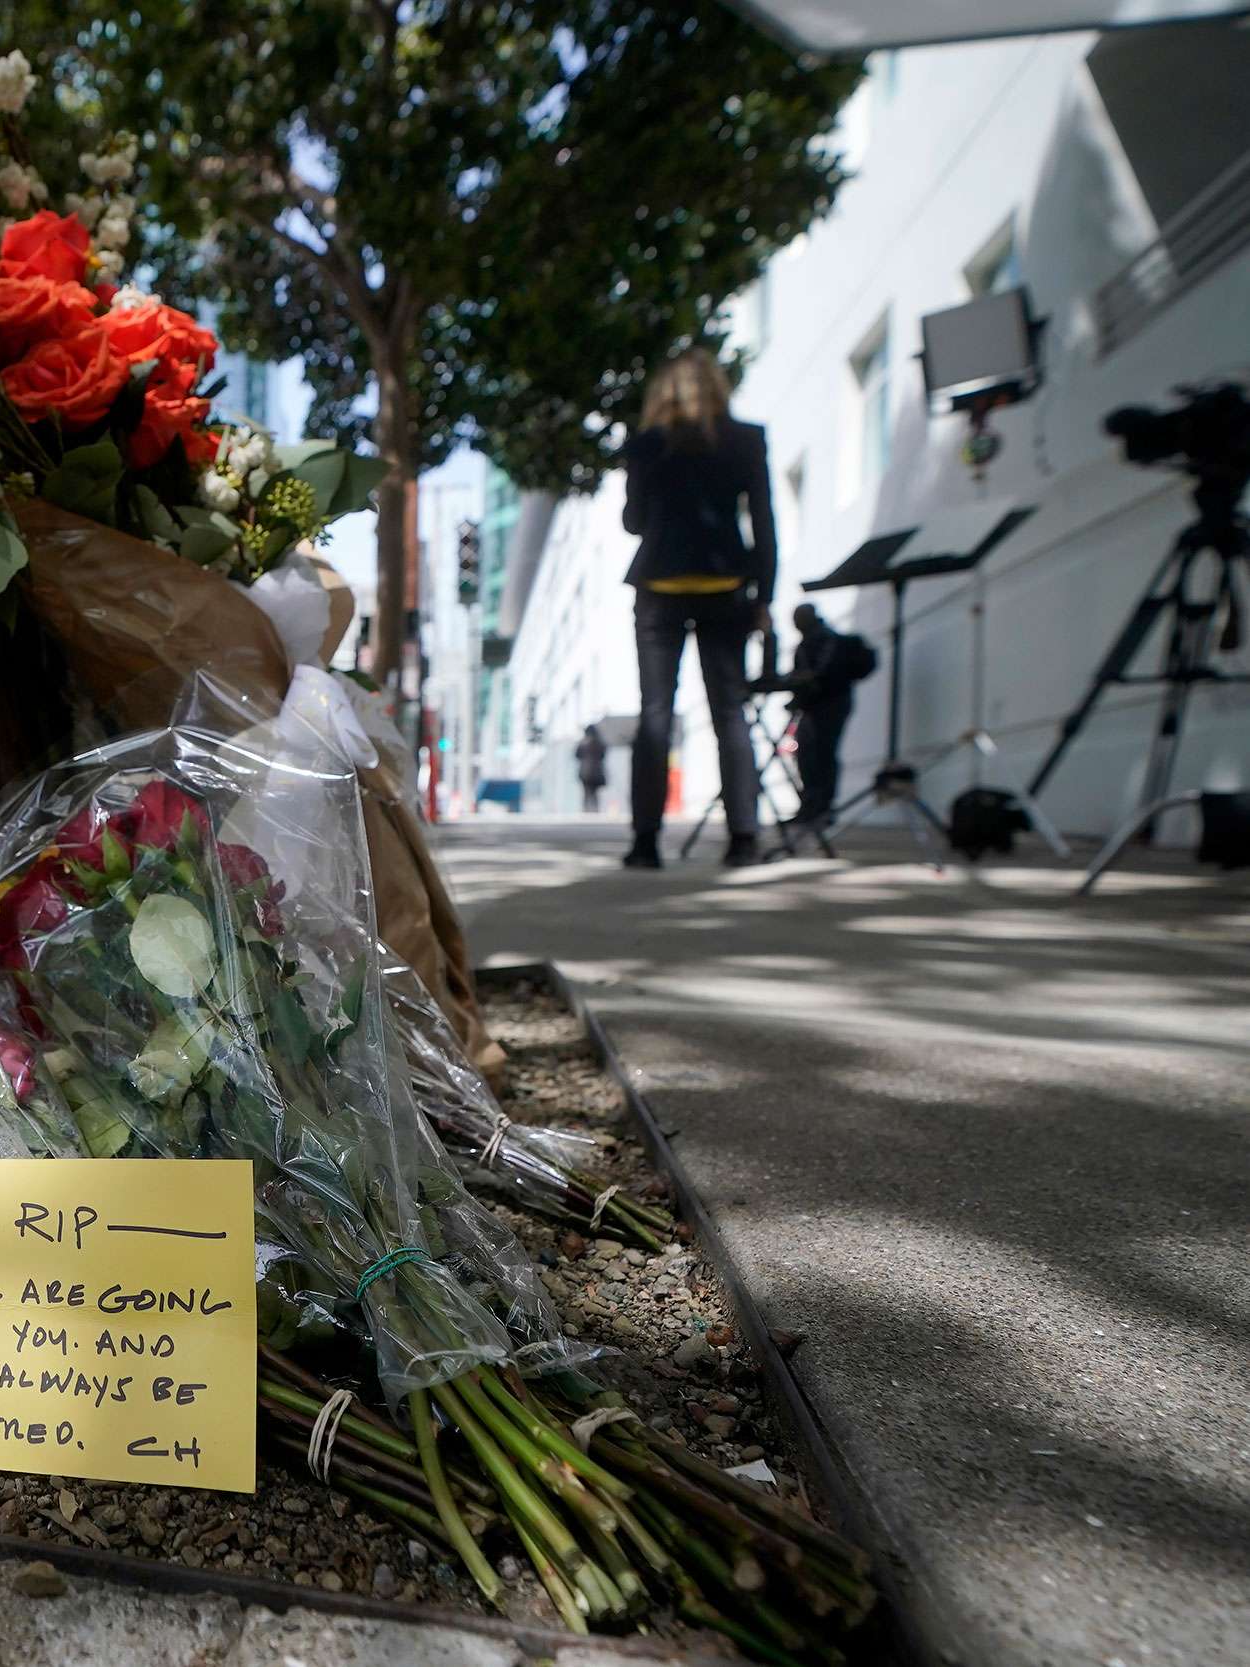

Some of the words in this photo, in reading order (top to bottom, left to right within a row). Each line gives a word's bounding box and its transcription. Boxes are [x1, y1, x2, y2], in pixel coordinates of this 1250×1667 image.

[20, 1278, 85, 1307] ARE
[97, 1283, 233, 1316] GOING
[12, 1319, 79, 1356] YOU.
[95, 1328, 175, 1358] AND
[152, 1376, 208, 1406] BE
[126, 1435, 202, 1469] CH
